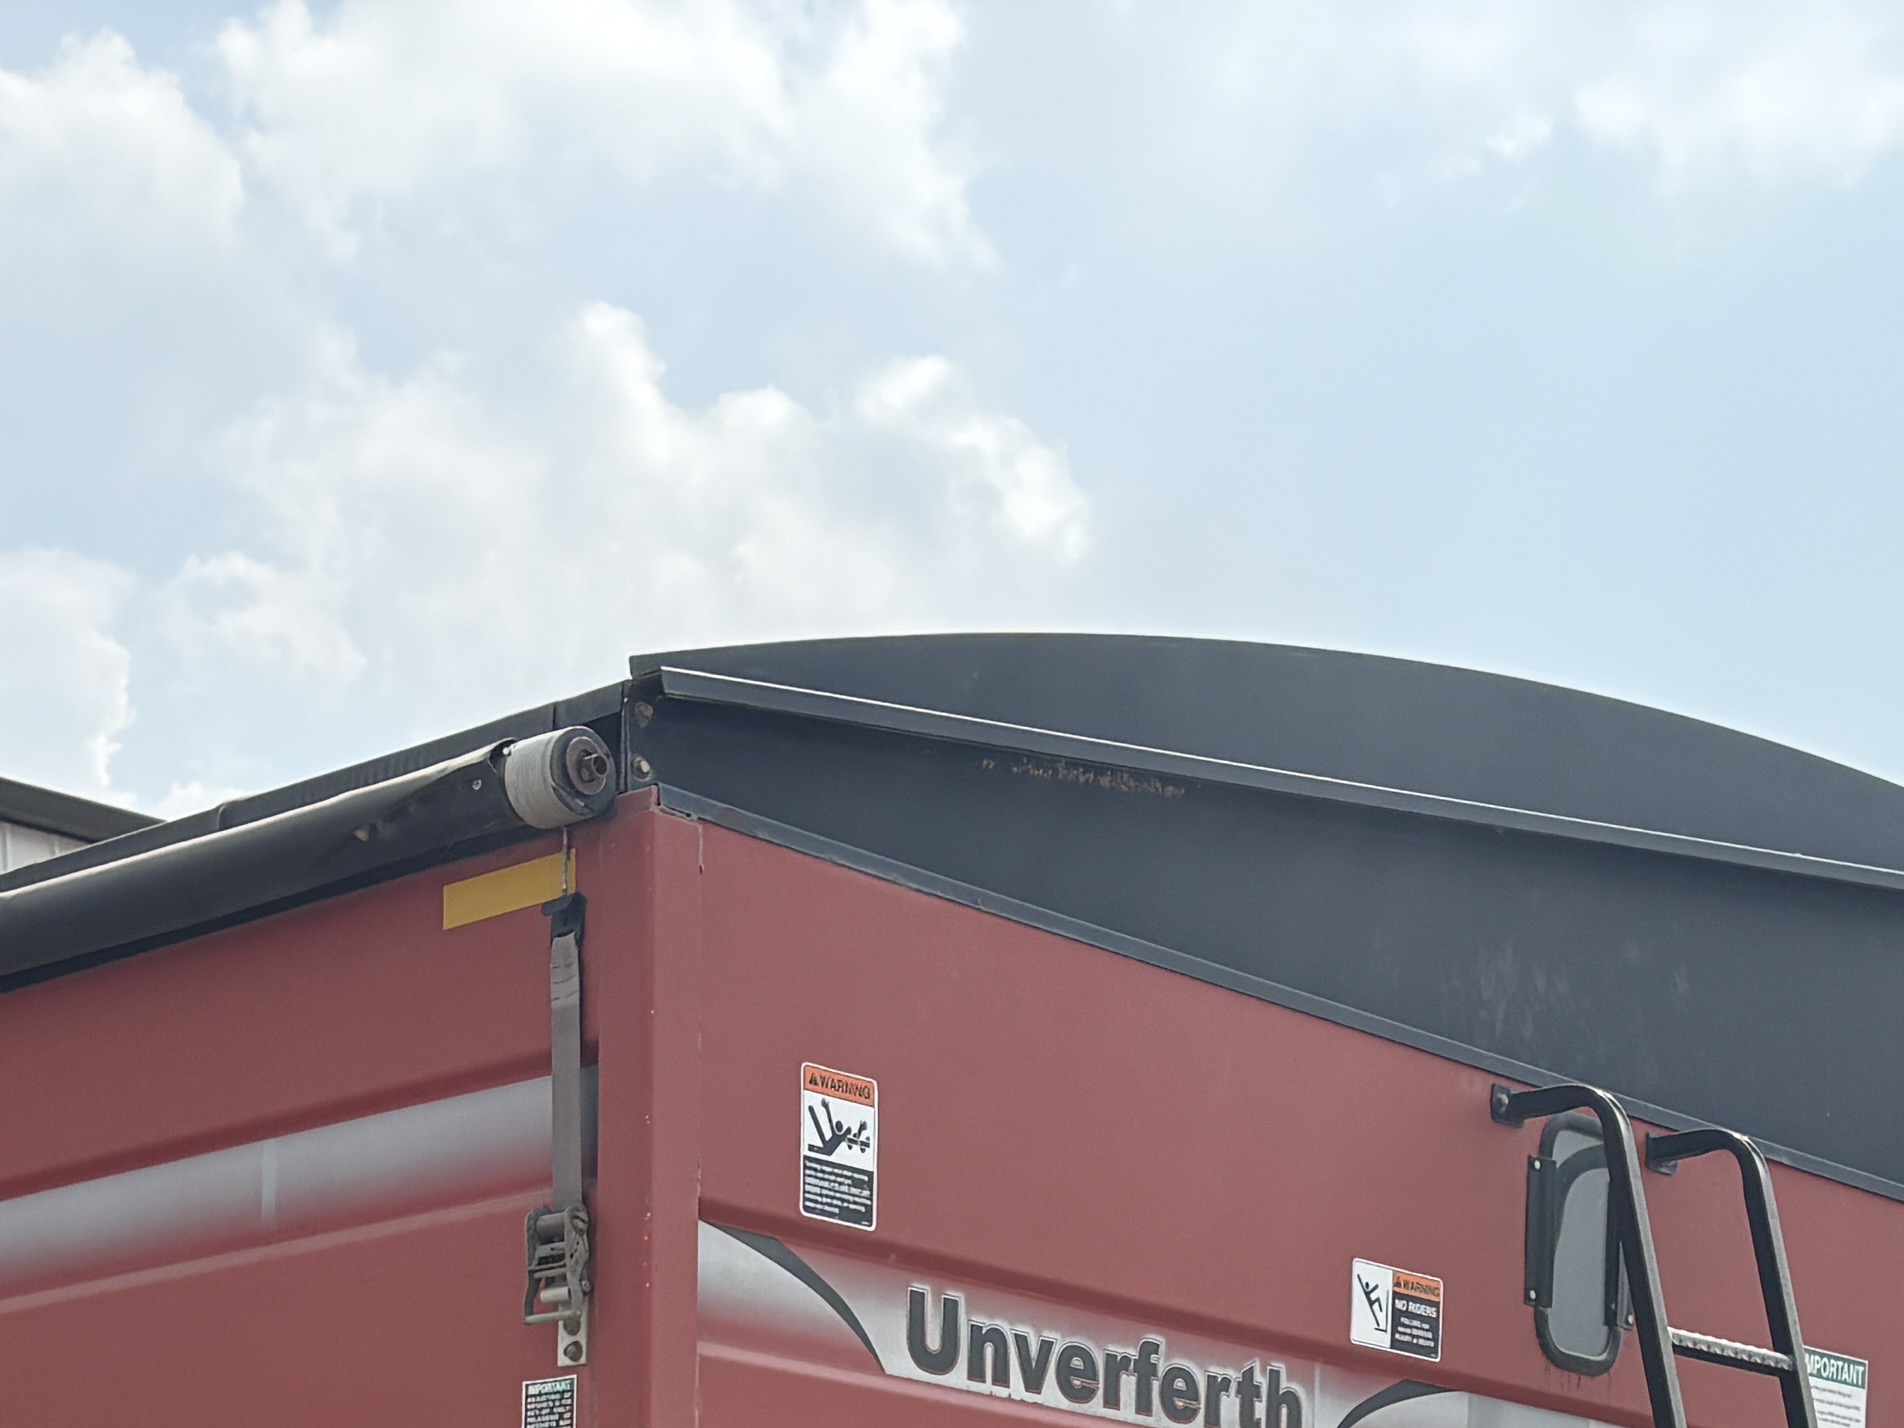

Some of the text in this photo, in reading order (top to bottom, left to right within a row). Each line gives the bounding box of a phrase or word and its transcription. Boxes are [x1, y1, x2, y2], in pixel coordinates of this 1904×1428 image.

[820, 1076, 871, 1100] WARNING
[1403, 1279, 1440, 1296] WARNING
[1395, 1299, 1437, 1318] NO RIDERS
[1805, 1353, 1865, 1386] MPORTANT
